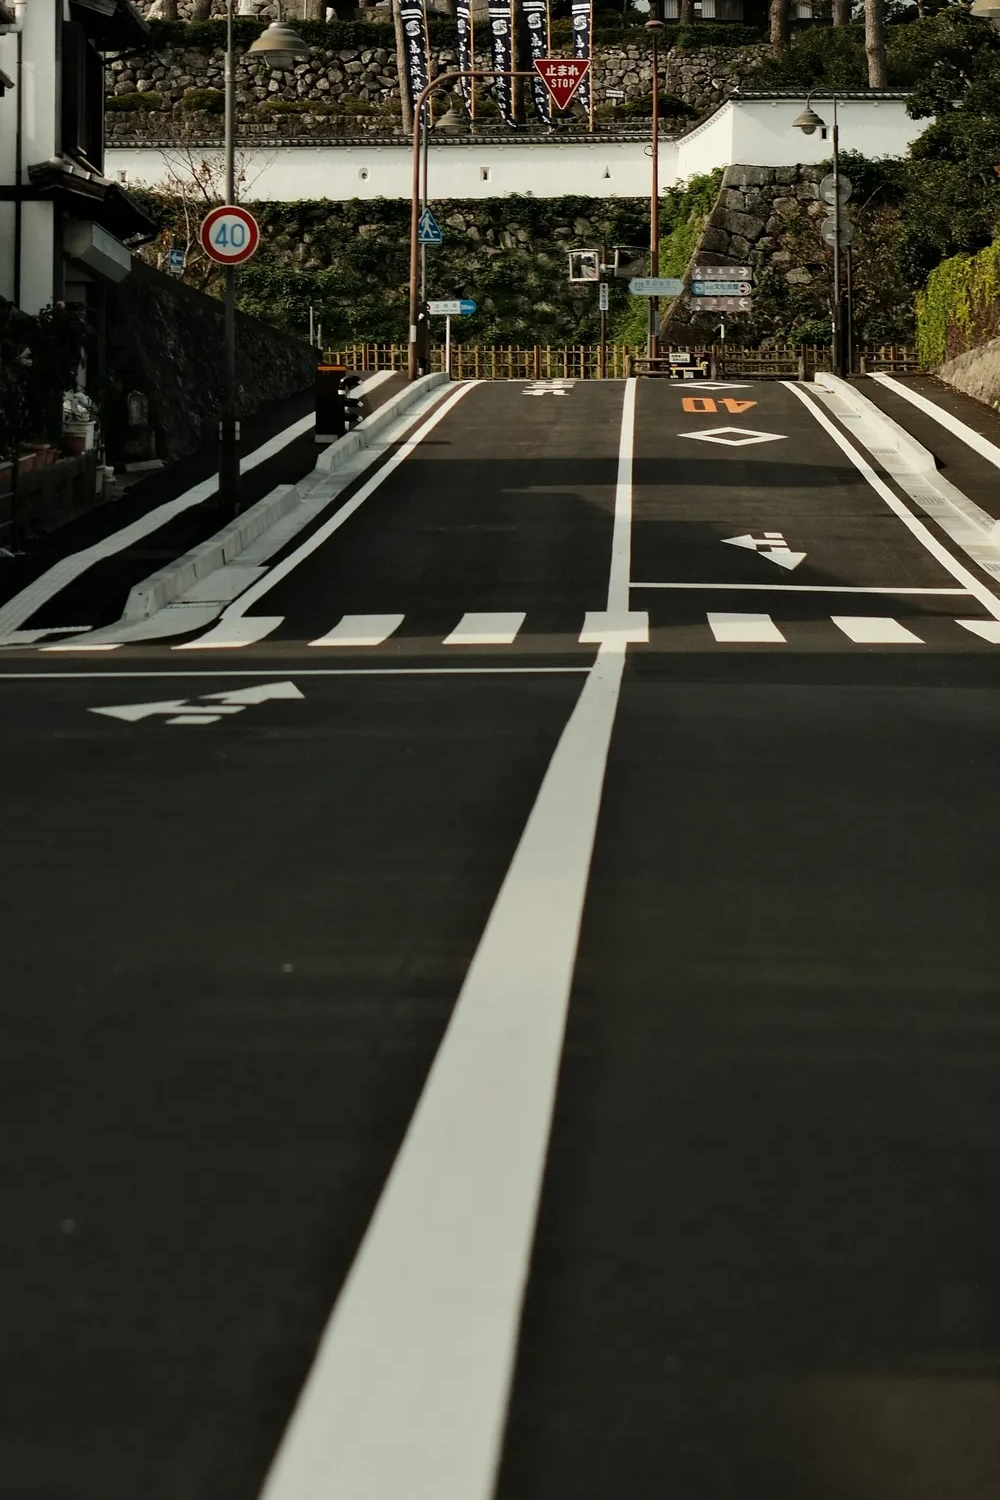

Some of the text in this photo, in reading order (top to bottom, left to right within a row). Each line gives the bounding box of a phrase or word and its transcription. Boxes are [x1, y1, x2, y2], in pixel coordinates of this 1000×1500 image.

[545, 64, 580, 76] 止まれ
[551, 78, 575, 88] STOP
[214, 223, 245, 248] 40
[681, 397, 758, 414] 40
